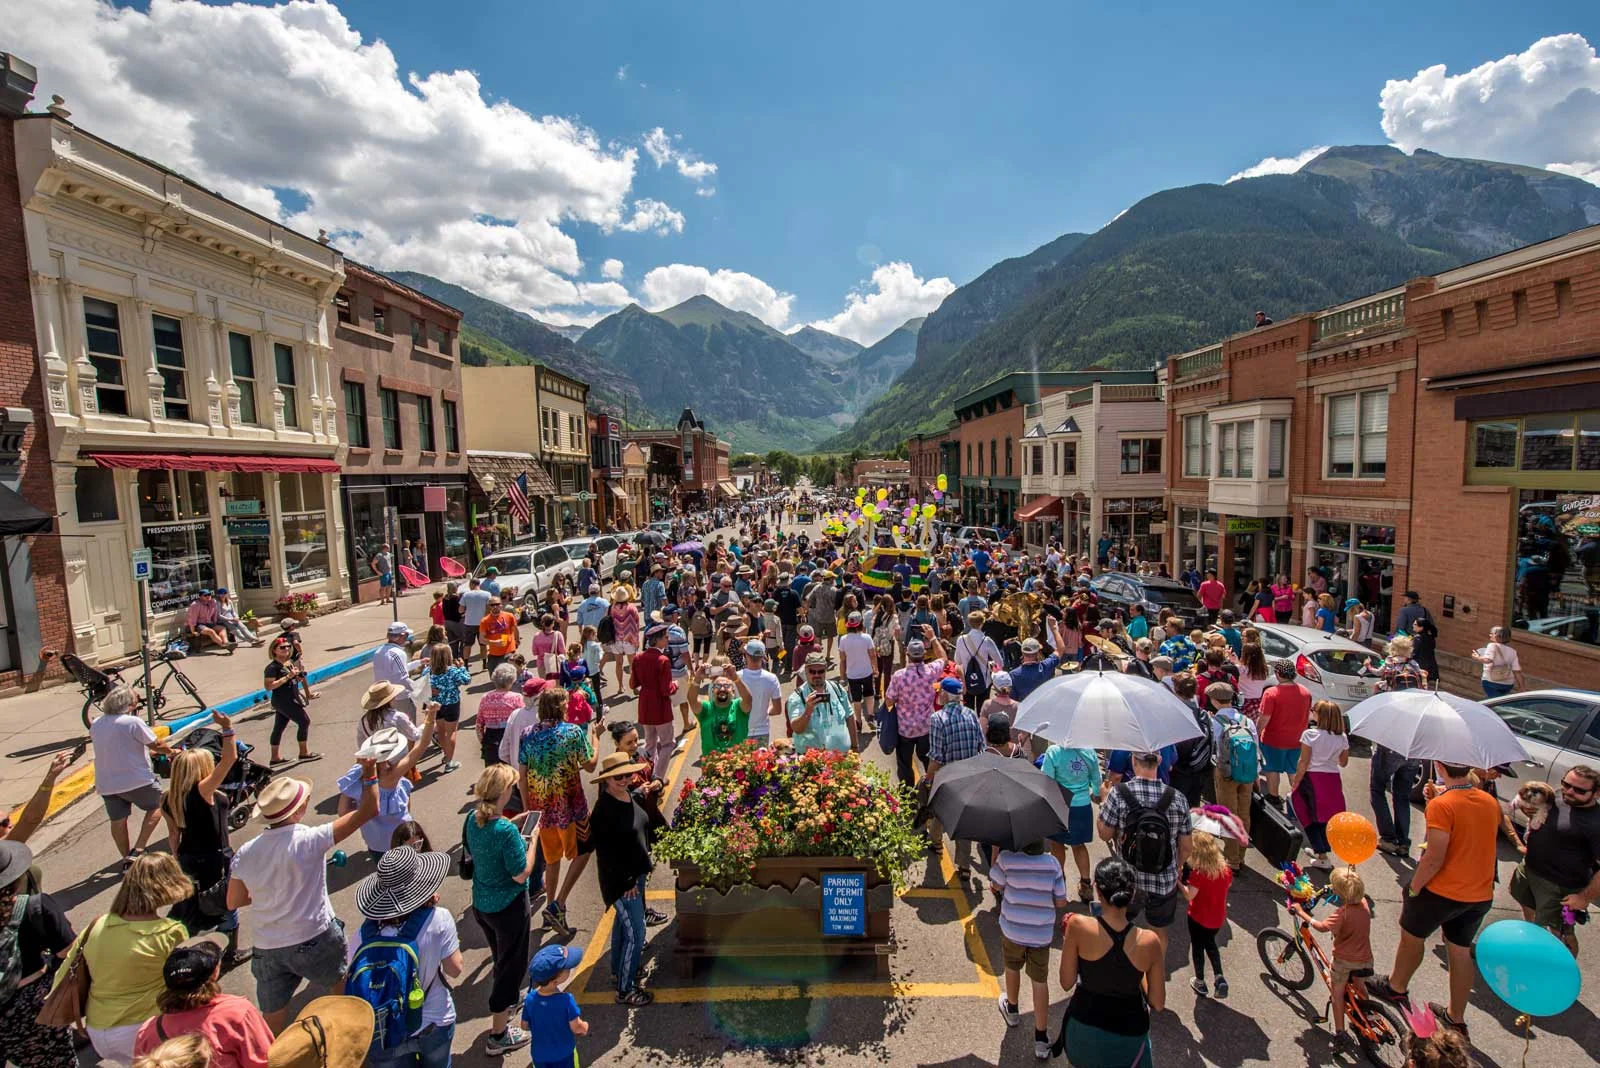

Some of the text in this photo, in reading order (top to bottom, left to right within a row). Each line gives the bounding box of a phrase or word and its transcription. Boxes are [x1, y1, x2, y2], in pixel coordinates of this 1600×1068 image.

[1562, 498, 1591, 512] GUIDED
[147, 523, 205, 534] PRESCRIPTION DRUGS
[152, 595, 190, 608] COMPOUNDING
[828, 878, 860, 887] PARKING
[837, 888, 863, 896] PERMIT
[834, 897, 852, 905] ONLY
[838, 908, 859, 916] MINUTE
